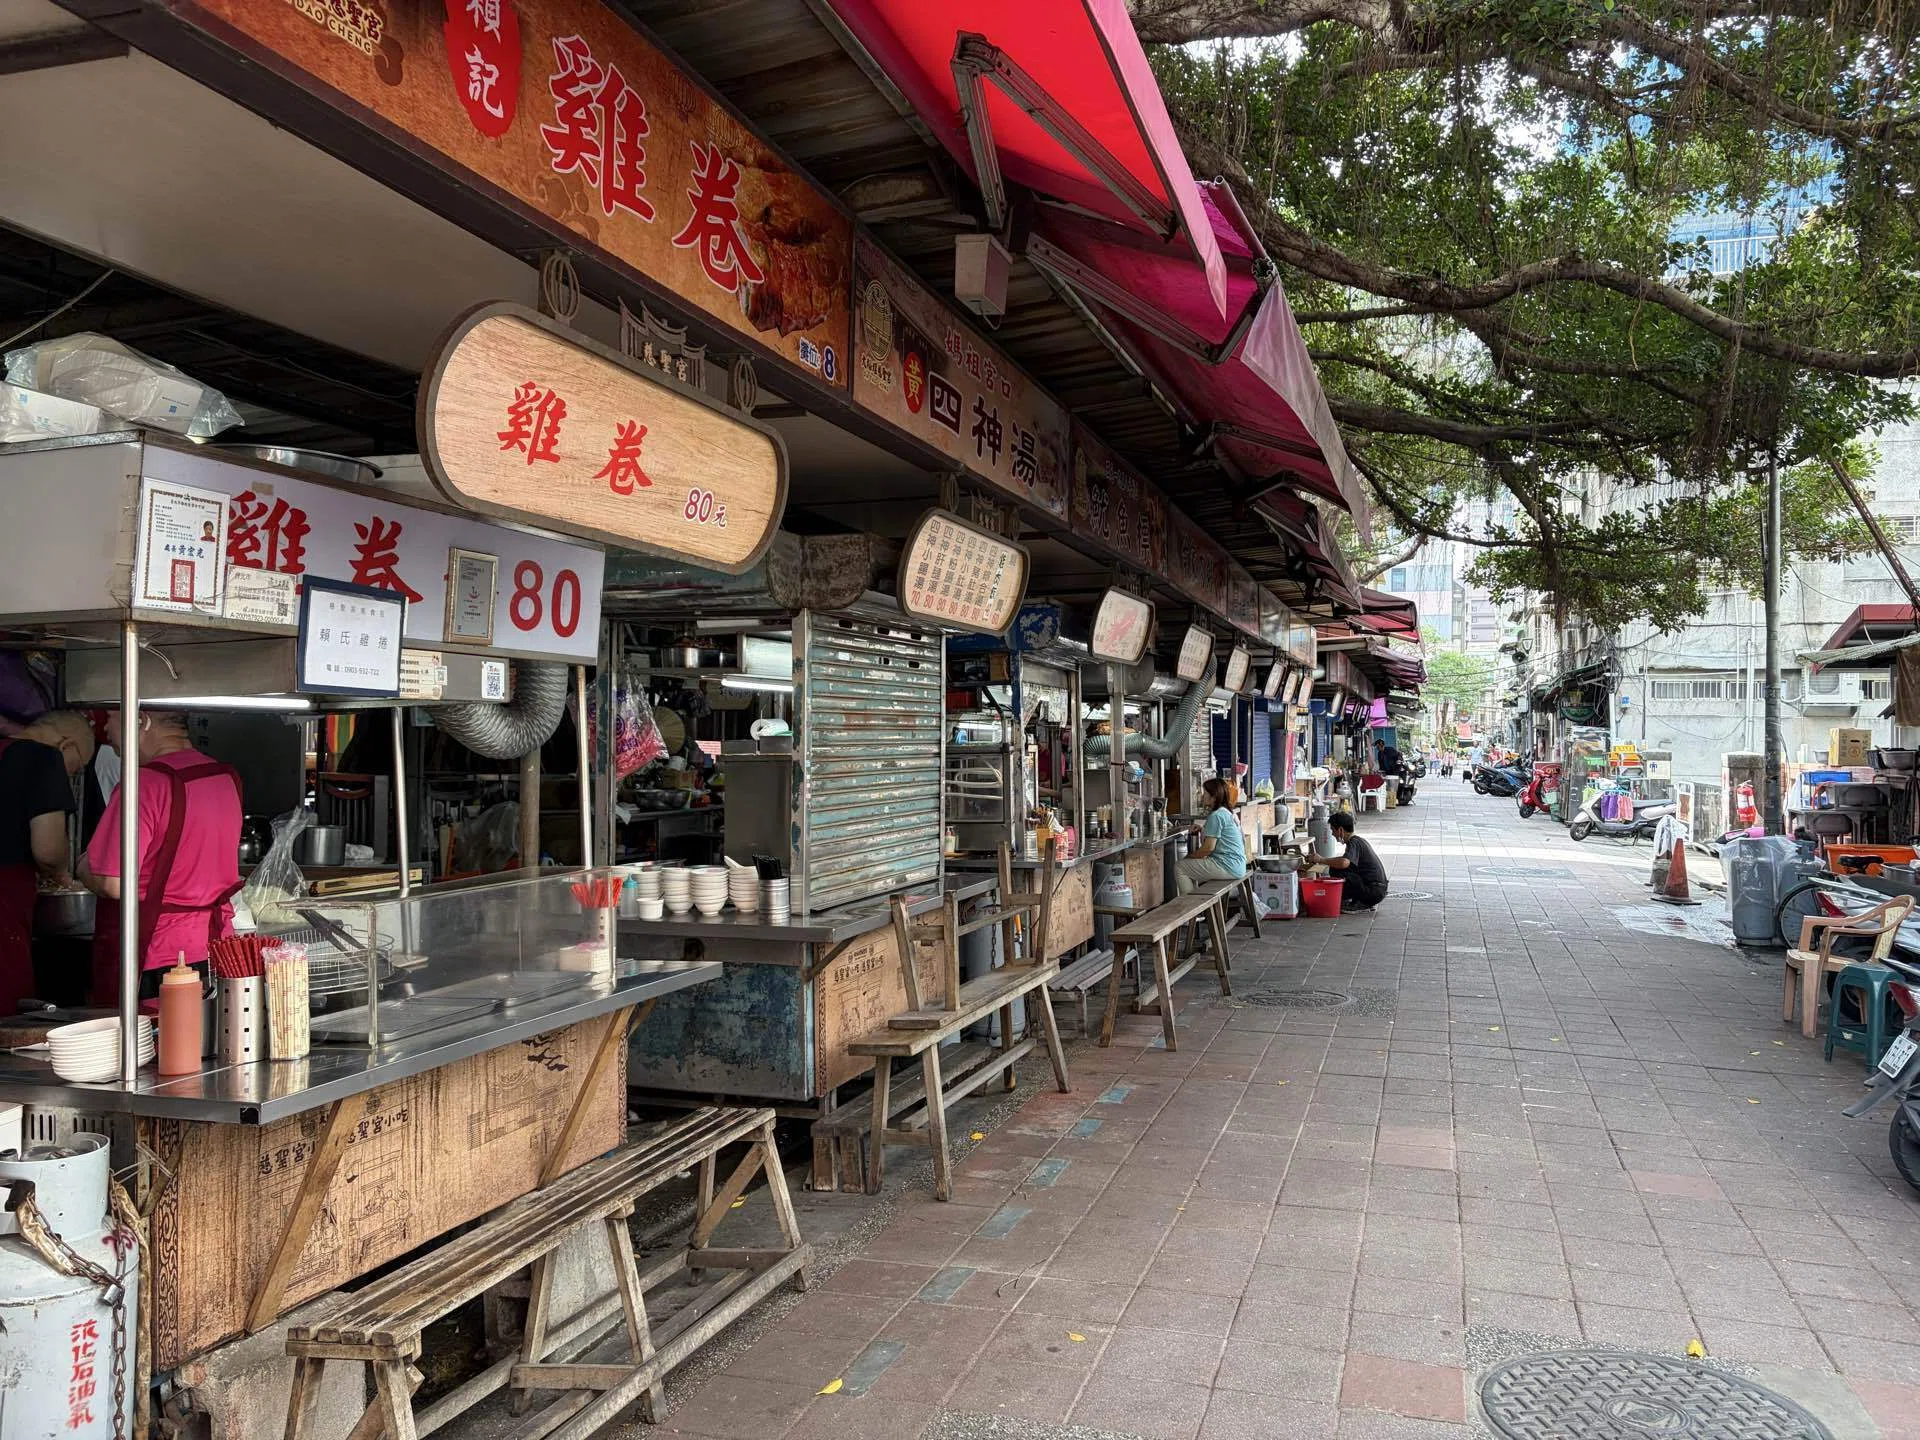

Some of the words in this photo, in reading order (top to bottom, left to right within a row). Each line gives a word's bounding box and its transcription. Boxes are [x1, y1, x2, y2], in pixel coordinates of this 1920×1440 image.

[328, 19, 372, 54] CHENG
[540, 34, 765, 293] 雞卷
[823, 345, 836, 381] 8
[905, 358, 923, 405] 黃
[945, 328, 1014, 399] 媽祖宮口
[497, 381, 652, 496] 雞卷
[928, 371, 1040, 488] 四神湯
[684, 487, 727, 528] 80元
[510, 560, 581, 638] 80
[319, 628, 389, 650] 賴氏雞捲
[66, 1318, 99, 1430] 液化石油氣
